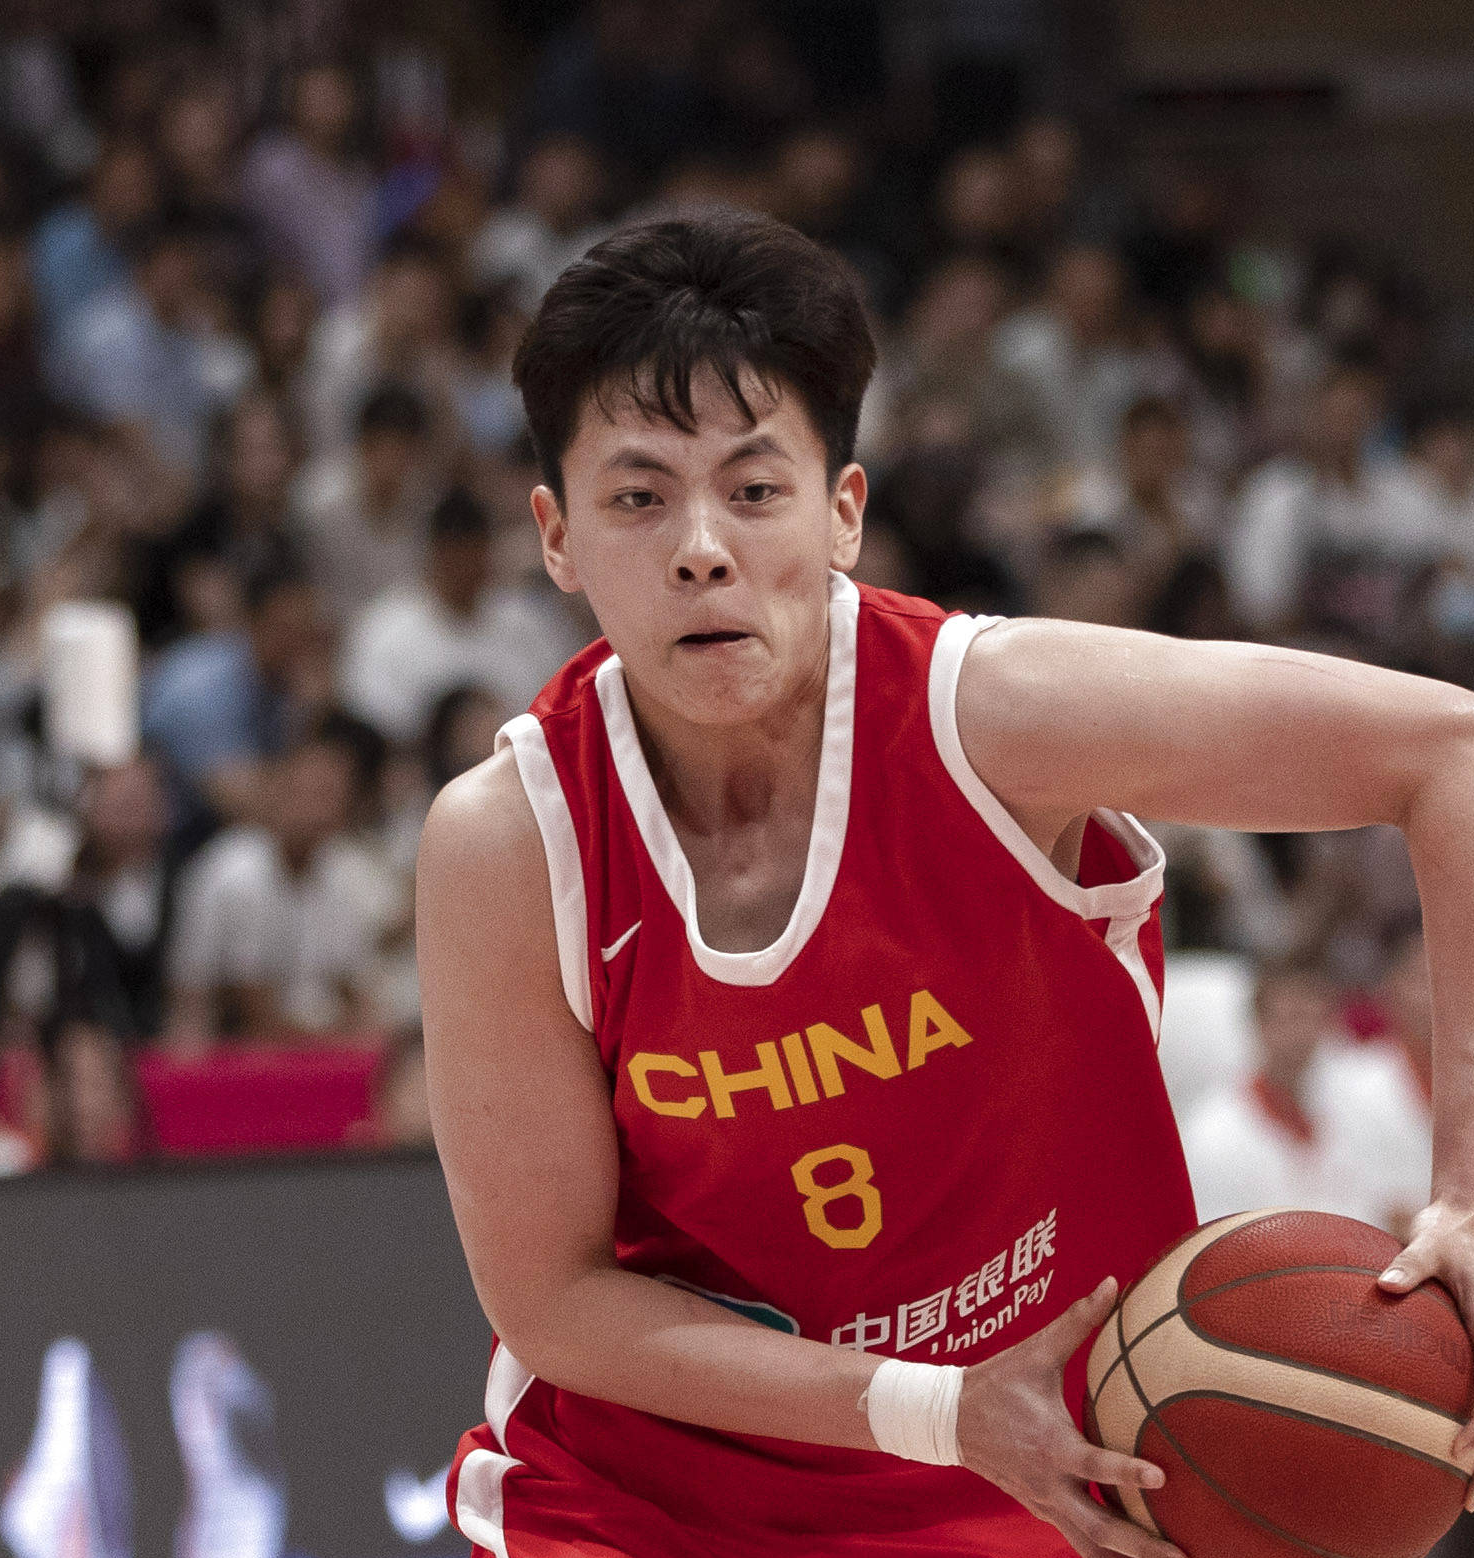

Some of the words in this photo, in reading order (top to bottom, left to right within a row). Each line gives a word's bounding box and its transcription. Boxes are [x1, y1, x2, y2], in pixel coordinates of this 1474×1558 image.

[627, 989, 974, 1119] CHINA
[790, 1143, 883, 1250] 8
[831, 1207, 1057, 1353] 中国银联
